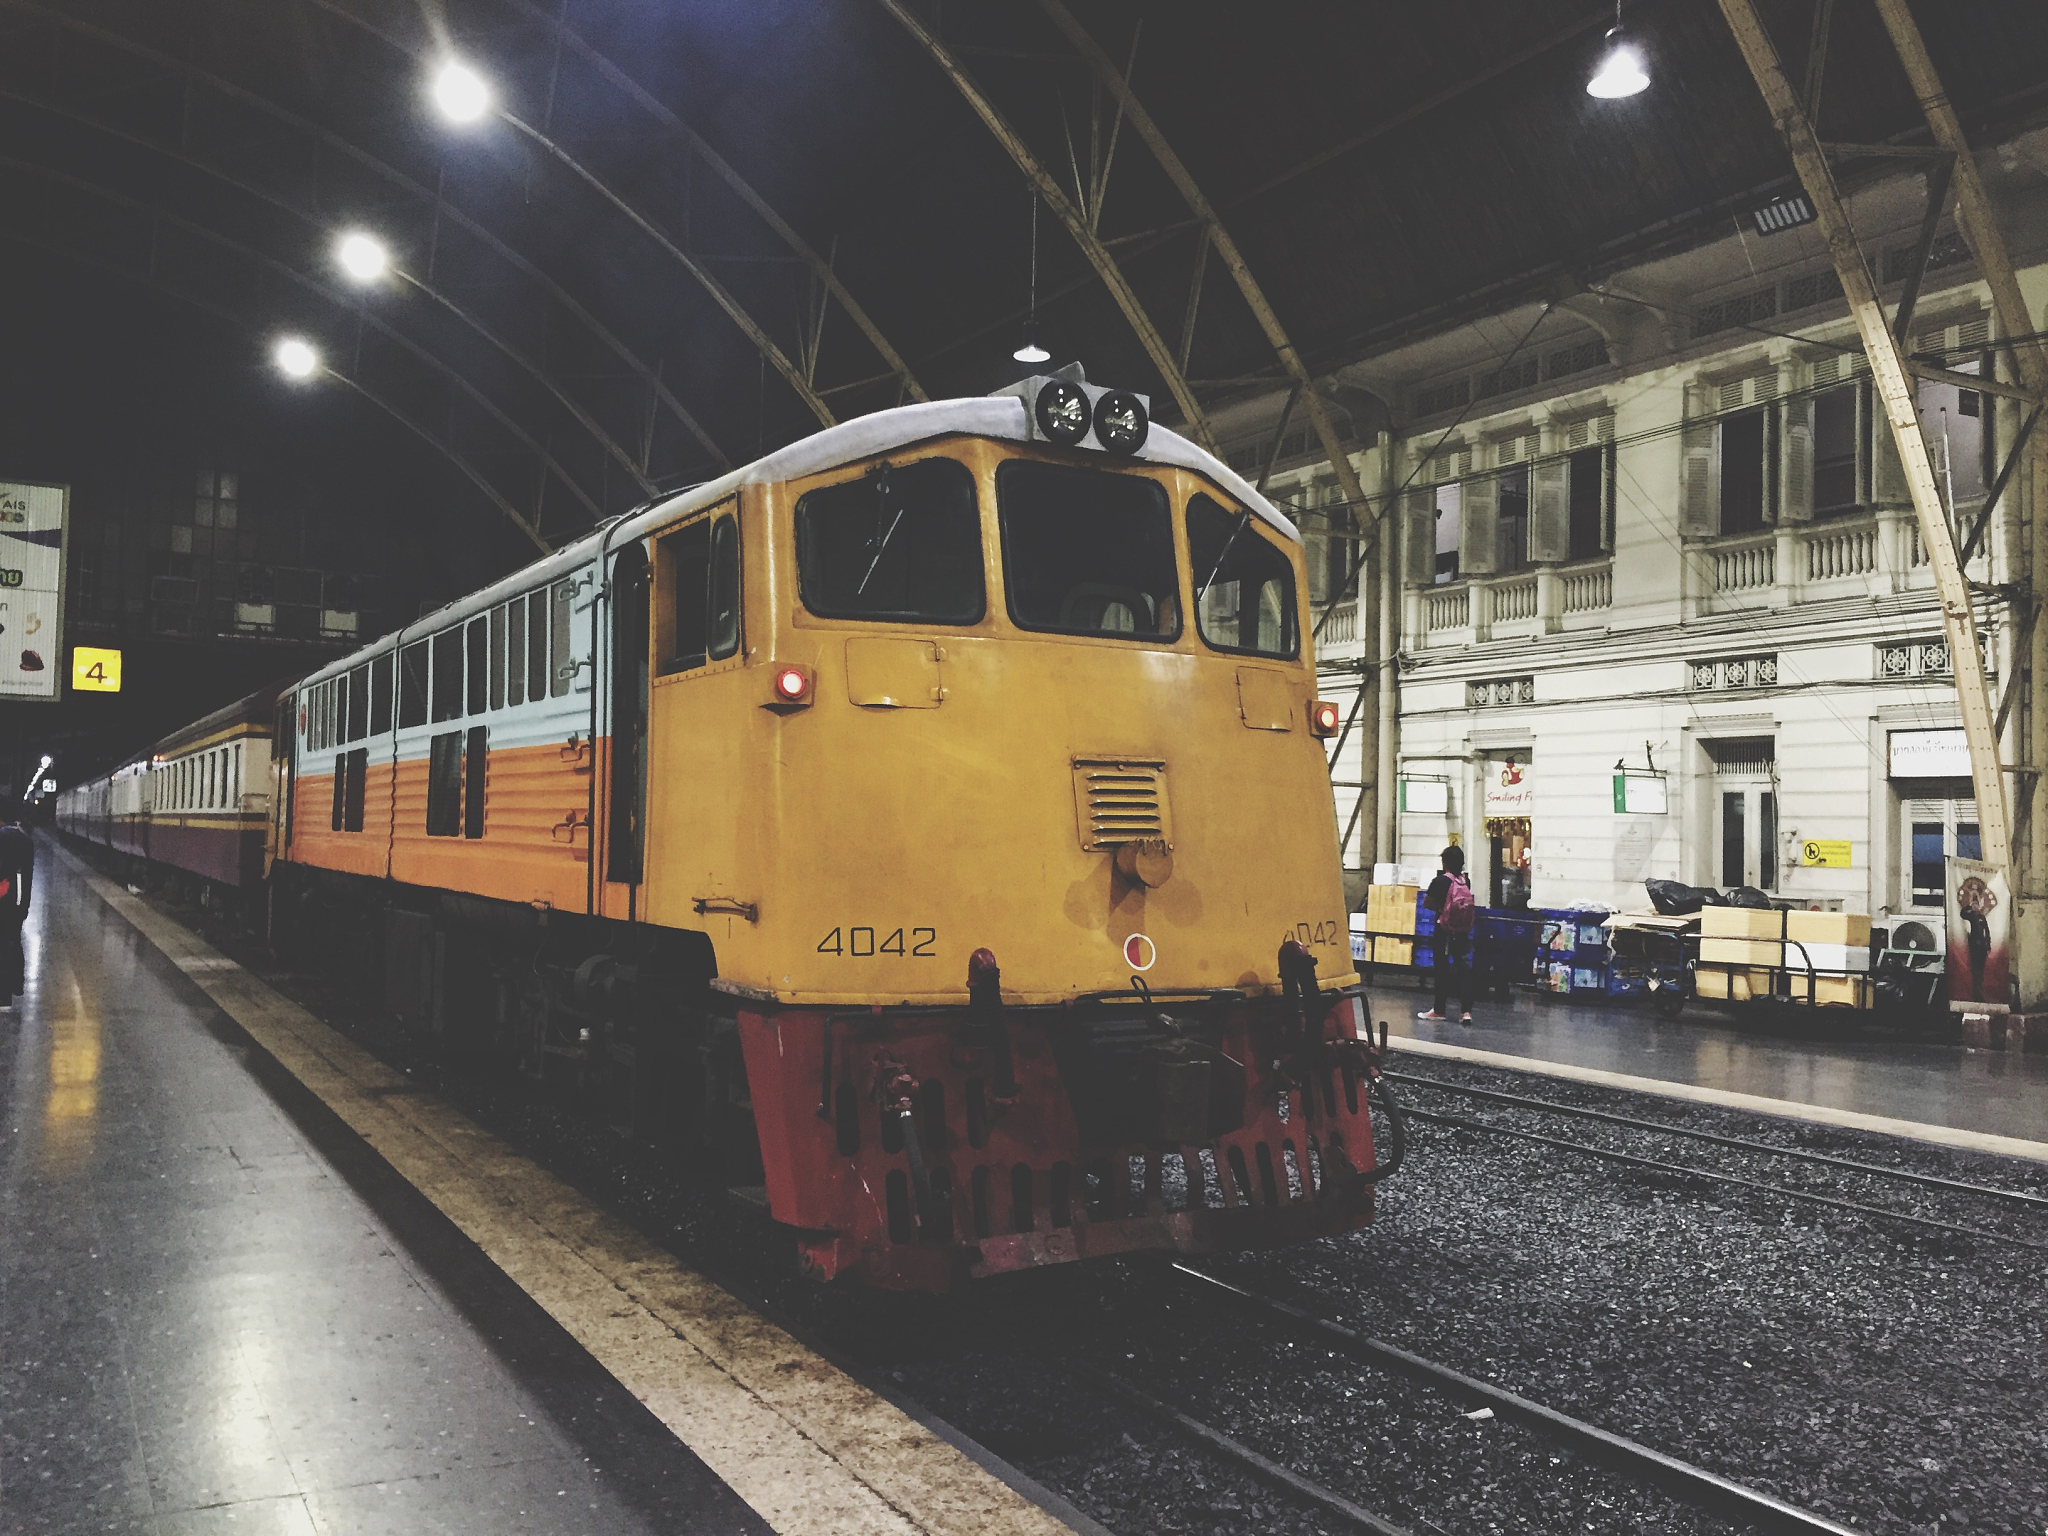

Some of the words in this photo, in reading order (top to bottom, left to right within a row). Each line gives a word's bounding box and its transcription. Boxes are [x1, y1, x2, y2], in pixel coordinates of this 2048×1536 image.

[3, 500, 26, 511] AIS
[85, 662, 108, 684] 4
[1486, 791, 1522, 806] Smiling
[817, 926, 936, 957] 4042
